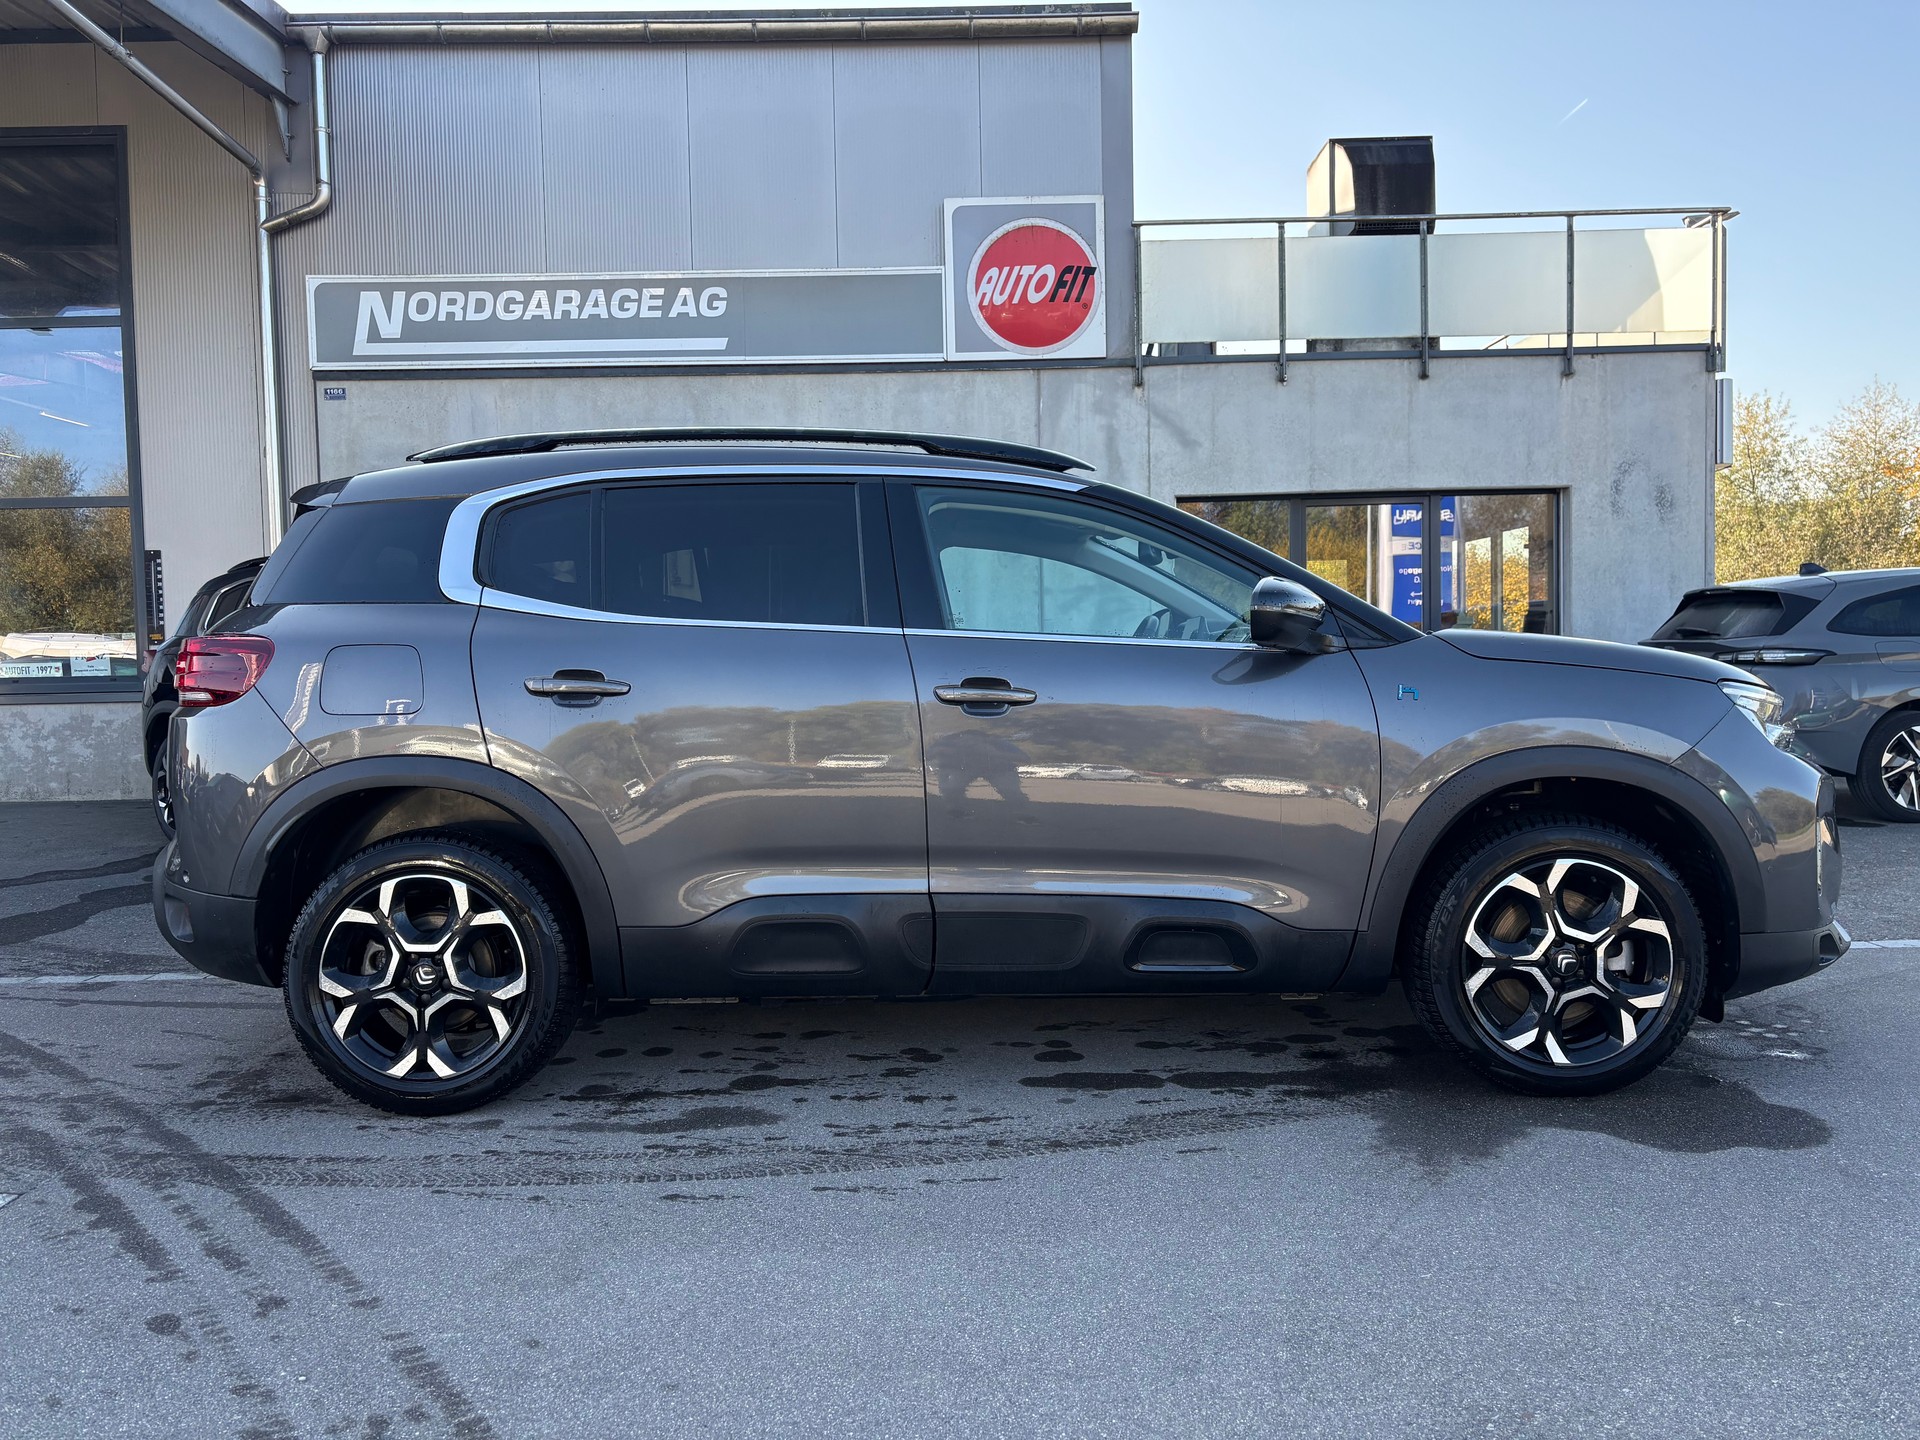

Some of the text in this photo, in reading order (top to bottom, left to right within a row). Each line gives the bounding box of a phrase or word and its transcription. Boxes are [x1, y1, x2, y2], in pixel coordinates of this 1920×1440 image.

[975, 264, 1097, 306] AUTOFIT
[353, 286, 728, 341] NORDGARAGE AG
[4, 666, 31, 675] AUTOFIT
[36, 666, 53, 674] 1997
